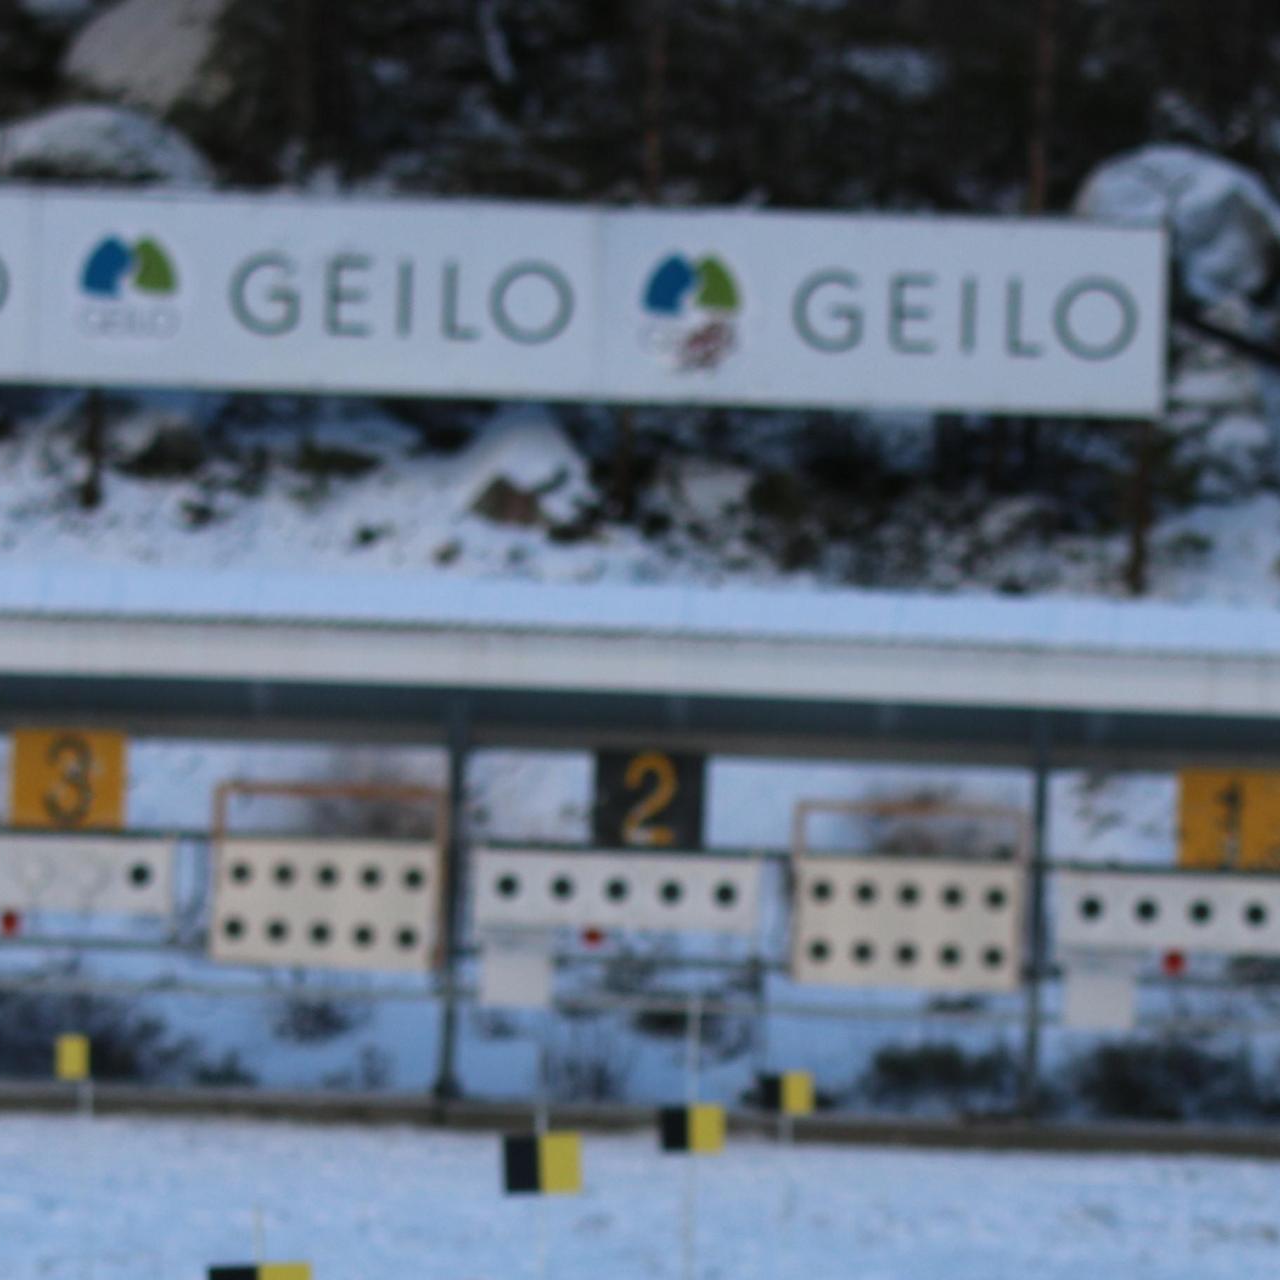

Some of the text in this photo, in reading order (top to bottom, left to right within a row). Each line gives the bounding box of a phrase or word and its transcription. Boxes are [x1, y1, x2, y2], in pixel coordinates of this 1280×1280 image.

[229, 249, 575, 346] GEILO
[792, 268, 1140, 362] GEILO
[43, 735, 92, 830] 3
[624, 751, 677, 847] 2
[1216, 781, 1243, 866] 1
